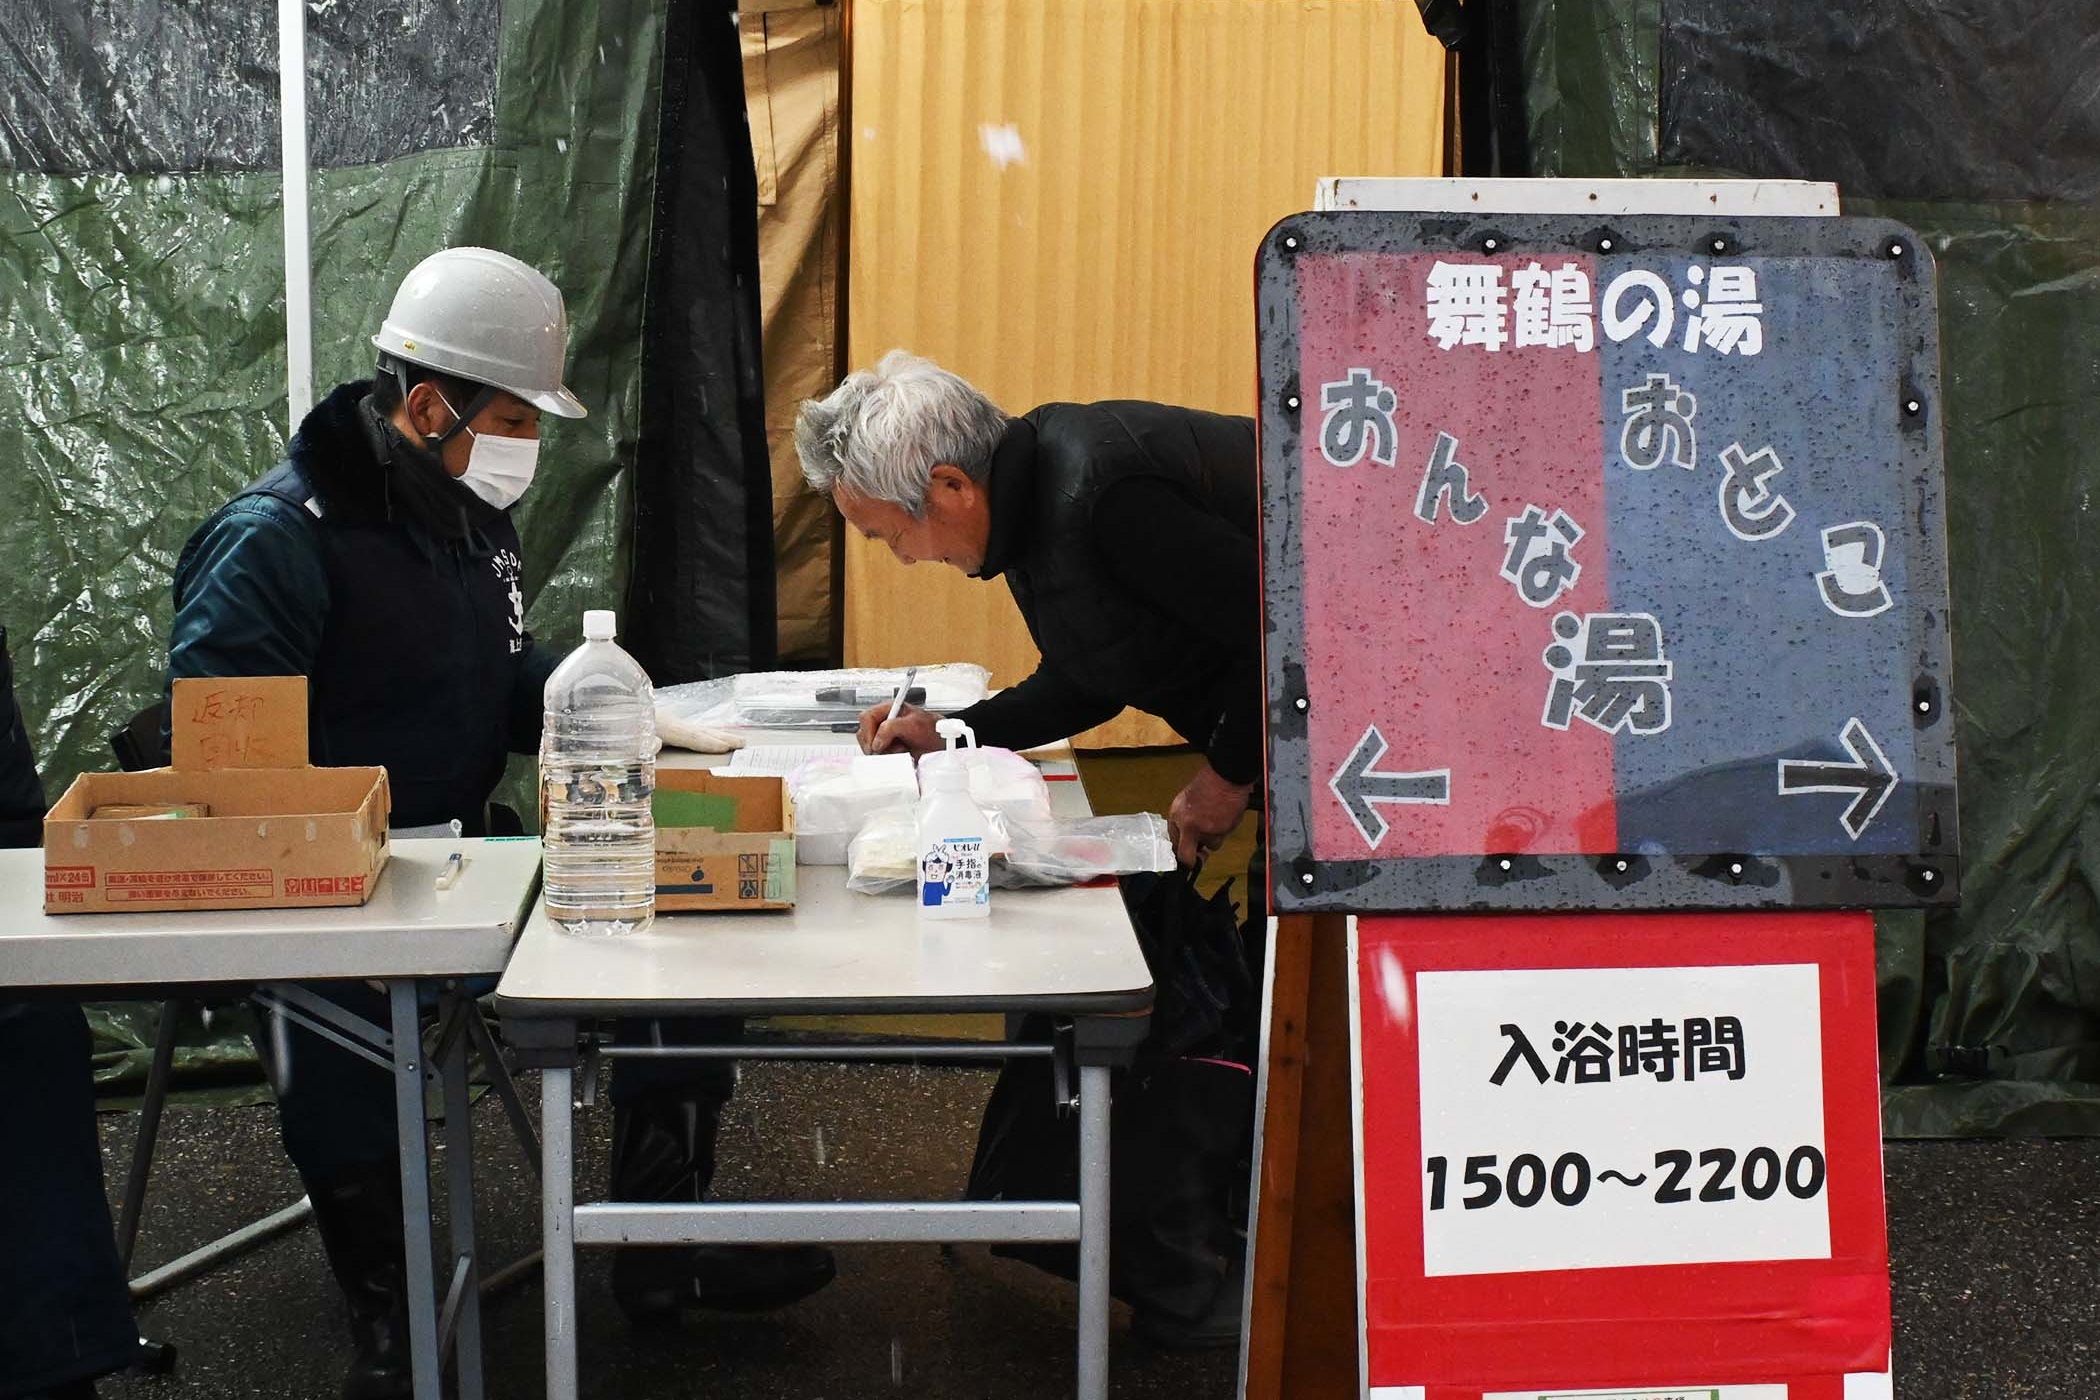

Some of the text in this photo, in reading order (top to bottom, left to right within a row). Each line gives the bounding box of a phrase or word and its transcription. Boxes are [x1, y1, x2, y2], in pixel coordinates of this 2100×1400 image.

[1425, 260, 1765, 356] 舞鶴の湯
[1319, 367, 1586, 608] おんな
[1621, 372, 1894, 618] おとこ
[1541, 611, 1673, 736] 湯
[1488, 1015, 1746, 1087] 入浴時間
